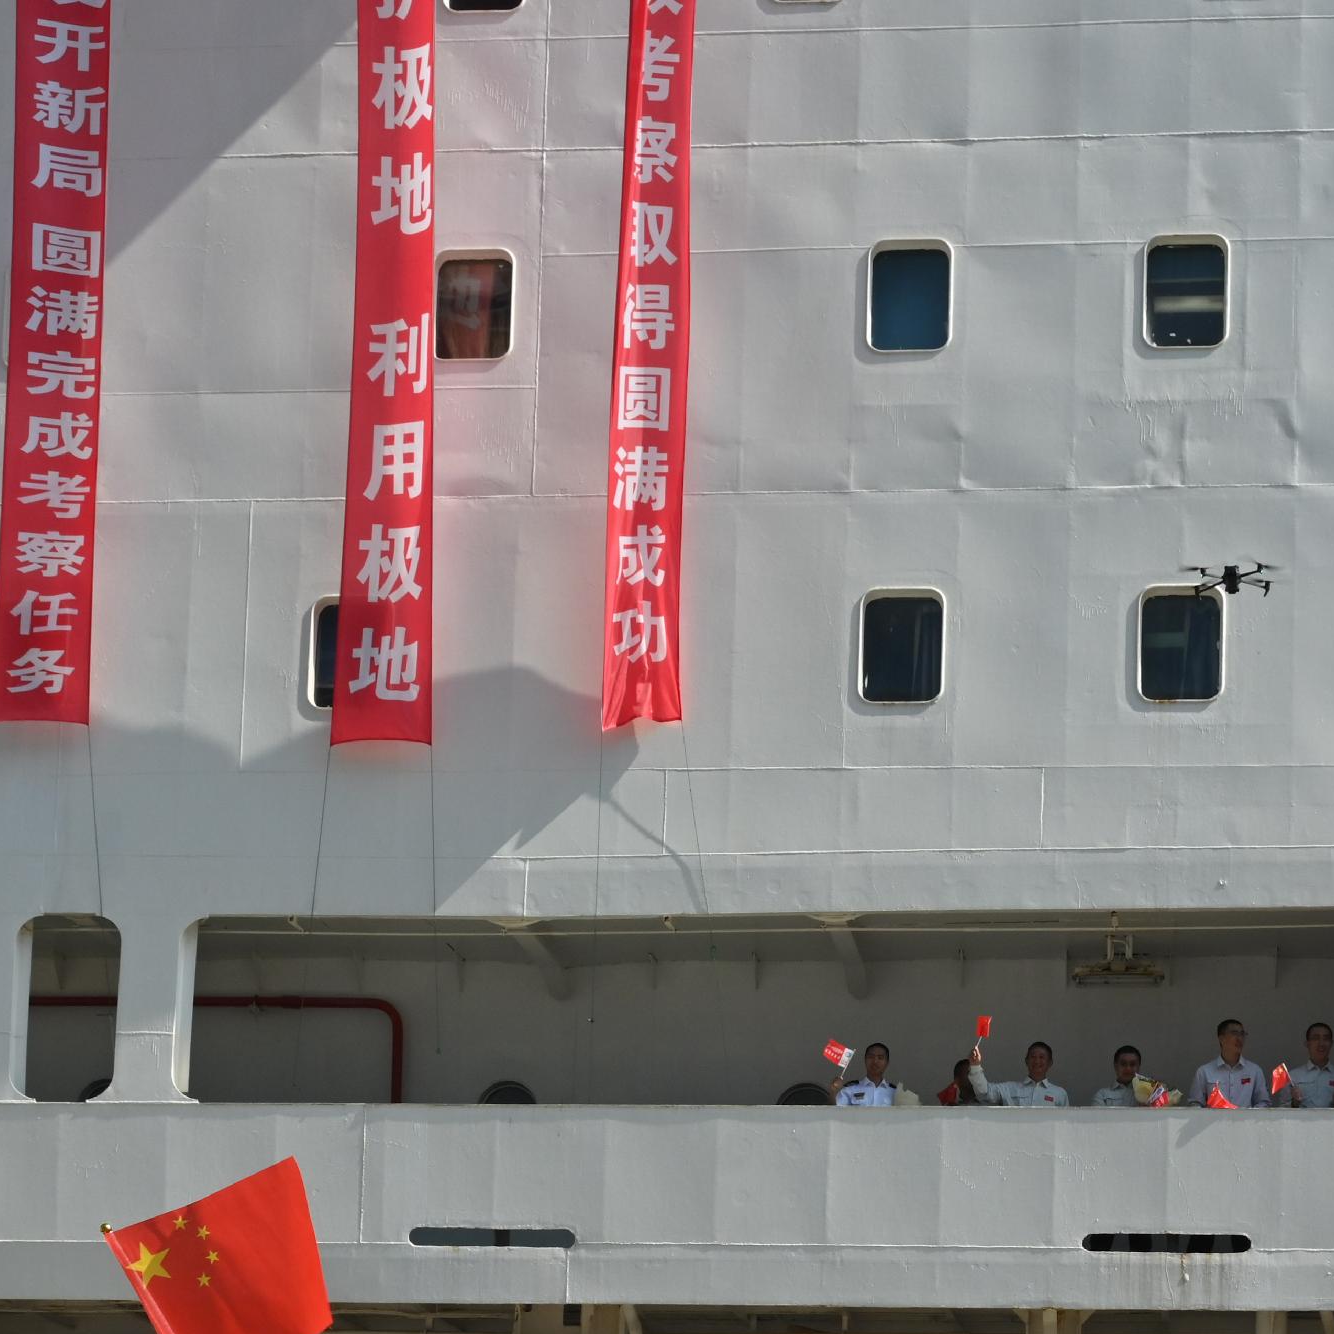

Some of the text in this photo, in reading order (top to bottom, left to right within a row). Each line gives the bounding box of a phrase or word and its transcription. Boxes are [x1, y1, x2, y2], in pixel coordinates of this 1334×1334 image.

[5, 0, 108, 696] 开新局 圆满完成考察任务
[349, 0, 434, 702] 极地 利用极地
[611, 0, 683, 663] 考察取得圆满成功
